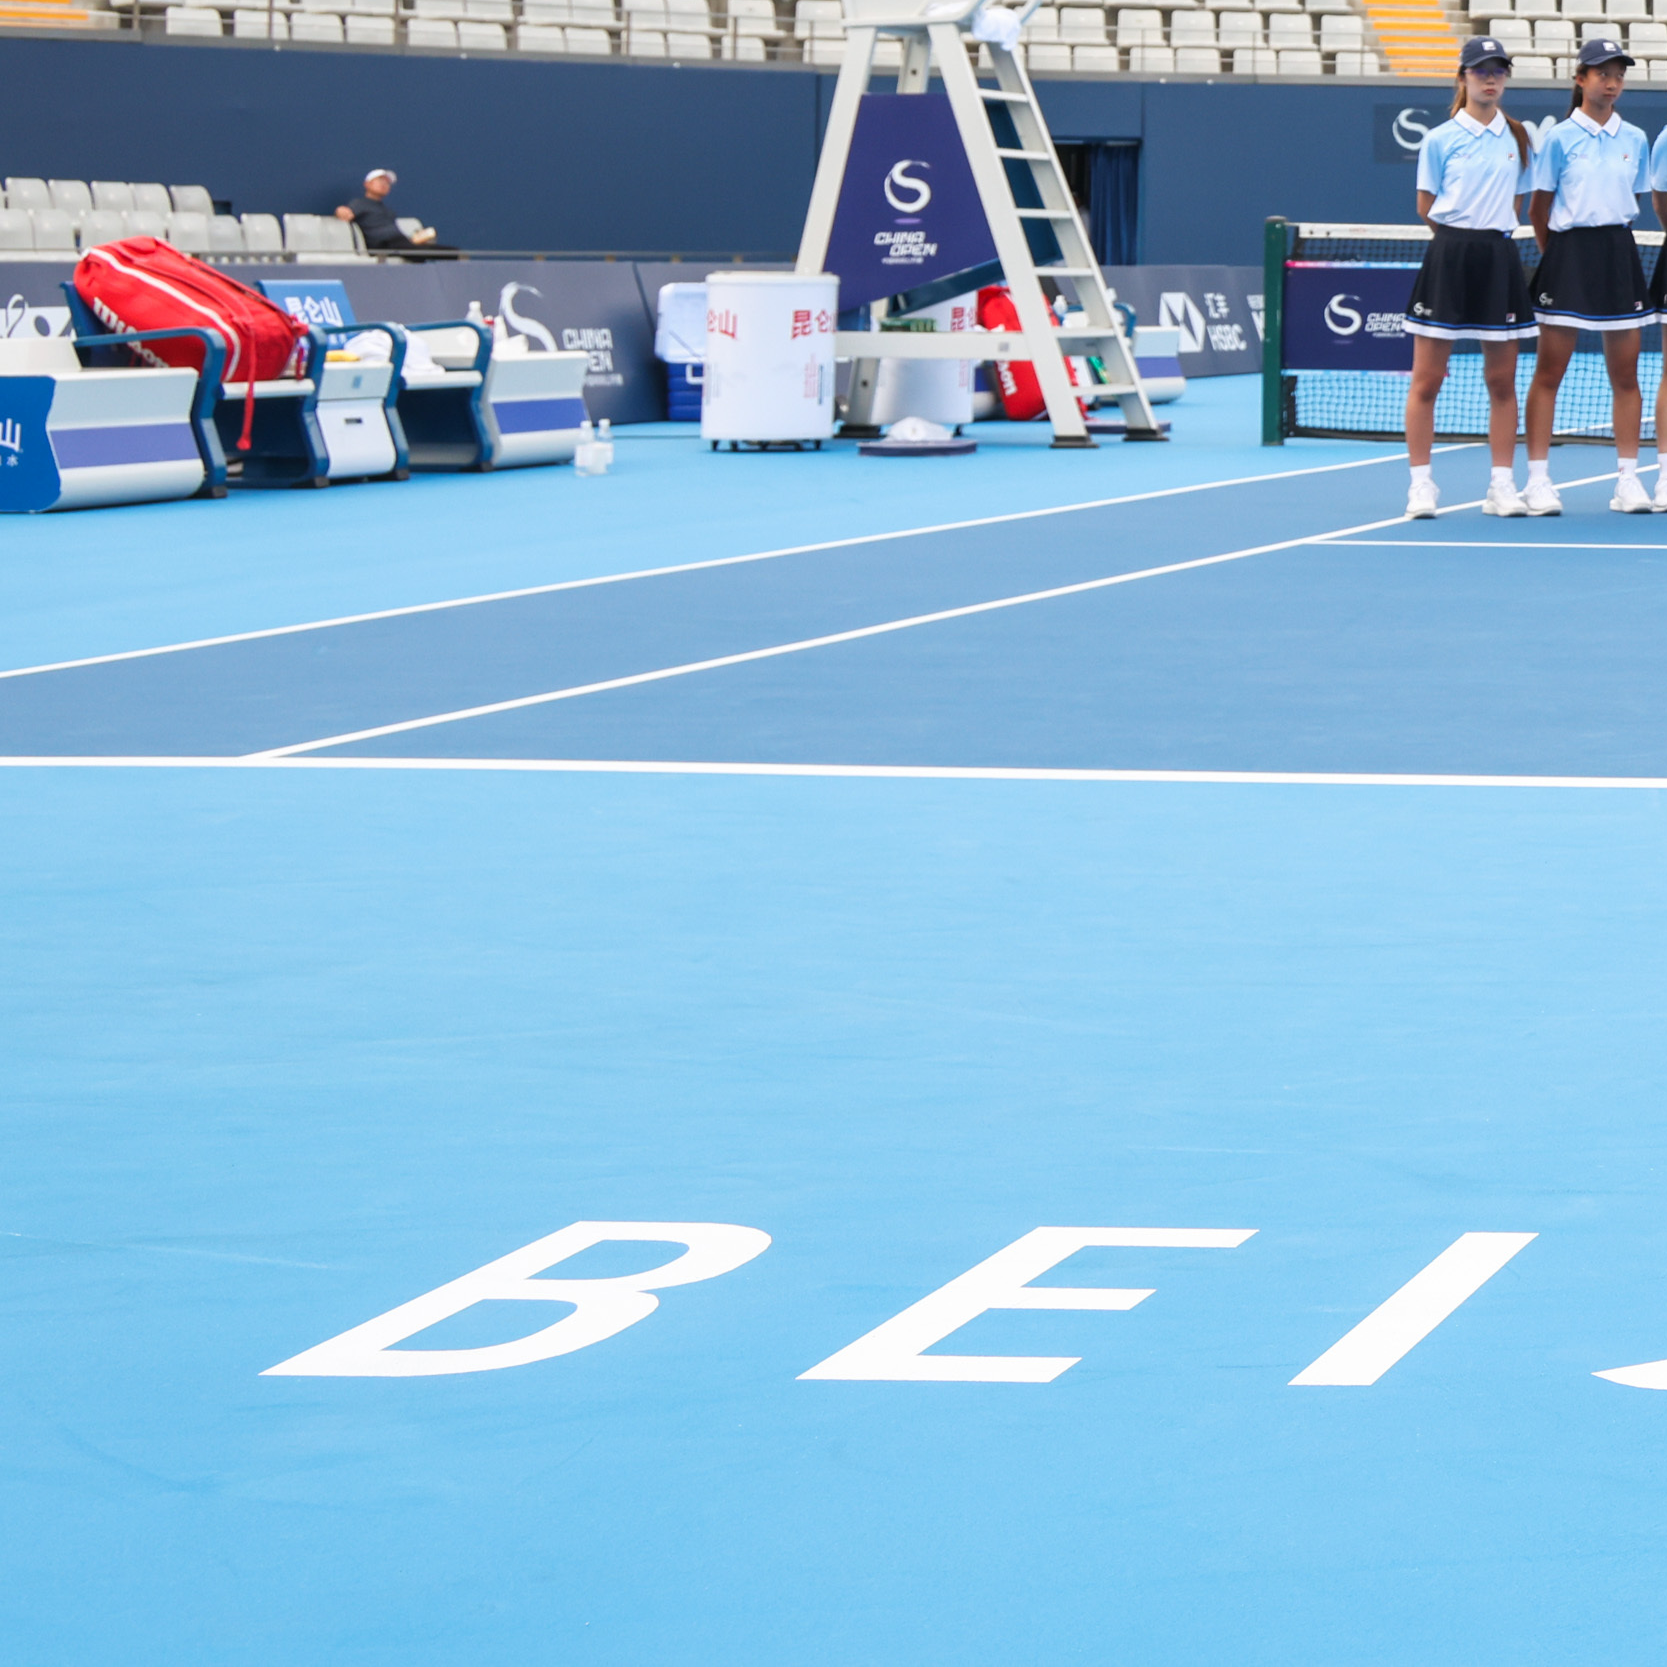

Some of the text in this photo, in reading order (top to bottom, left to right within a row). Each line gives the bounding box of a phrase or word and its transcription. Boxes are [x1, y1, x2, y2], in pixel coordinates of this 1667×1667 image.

[889, 243, 938, 257] OPEN
[1206, 323, 1248, 351] HSBC
[588, 350, 613, 372] EN
